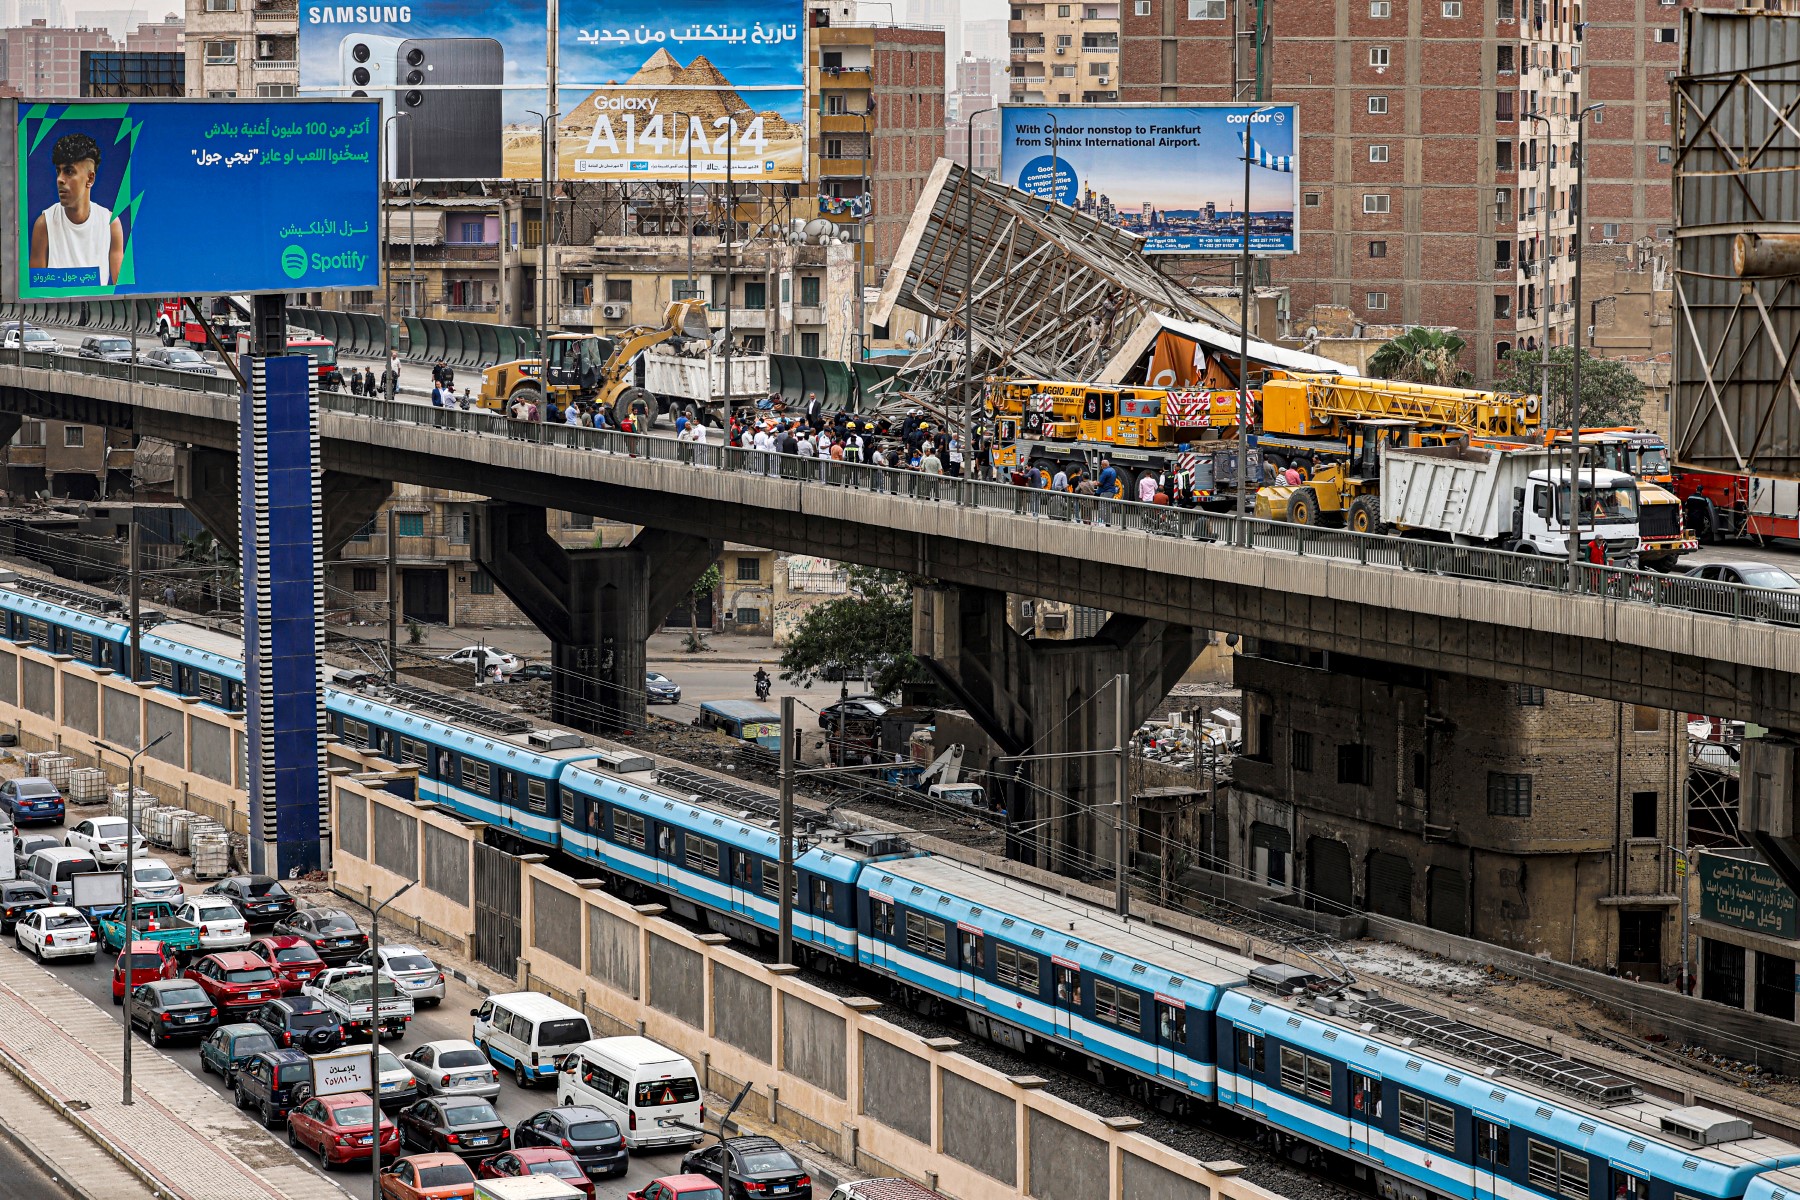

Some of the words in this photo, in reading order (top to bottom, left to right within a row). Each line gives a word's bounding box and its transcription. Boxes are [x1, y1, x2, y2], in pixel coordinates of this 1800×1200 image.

[309, 6, 412, 24] SAMSUNG
[577, 29, 631, 45] جديد
[634, 24, 666, 45] من
[670, 24, 747, 44] بيتكتب
[751, 21, 797, 44] تاريخ
[594, 95, 658, 114] Galaxy
[1226, 110, 1272, 124] condor
[204, 121, 239, 139] ببلاش
[240, 117, 271, 138] أغنية
[271, 121, 303, 139] مليون
[305, 121, 327, 135] 100
[329, 126, 346, 138] من
[346, 116, 370, 139] أكتر
[585, 114, 669, 154] A14
[678, 116, 769, 155] A24
[1016, 124, 1041, 134] With
[1044, 124, 1085, 135] Condor
[1087, 125, 1132, 136] nonstop
[1135, 125, 1147, 134] to
[1149, 124, 1202, 134] Frankfurt
[1016, 137, 1042, 147] from
[1044, 137, 1082, 149] Sphinx
[1085, 138, 1155, 147] International
[1158, 138, 1201, 149] Airport.
[259, 148, 282, 166] عايز
[283, 147, 294, 165] لو
[296, 147, 326, 165] اللعب
[1027, 171, 1067, 181] connectons
[1037, 185, 1068, 193] Gerany,
[311, 250, 366, 273] Spotify
[62, 272, 78, 283] جول
[79, 271, 97, 283] تيجي
[1716, 899, 1755, 922] مارسيليا
[1757, 908, 1782, 931] وكيل
